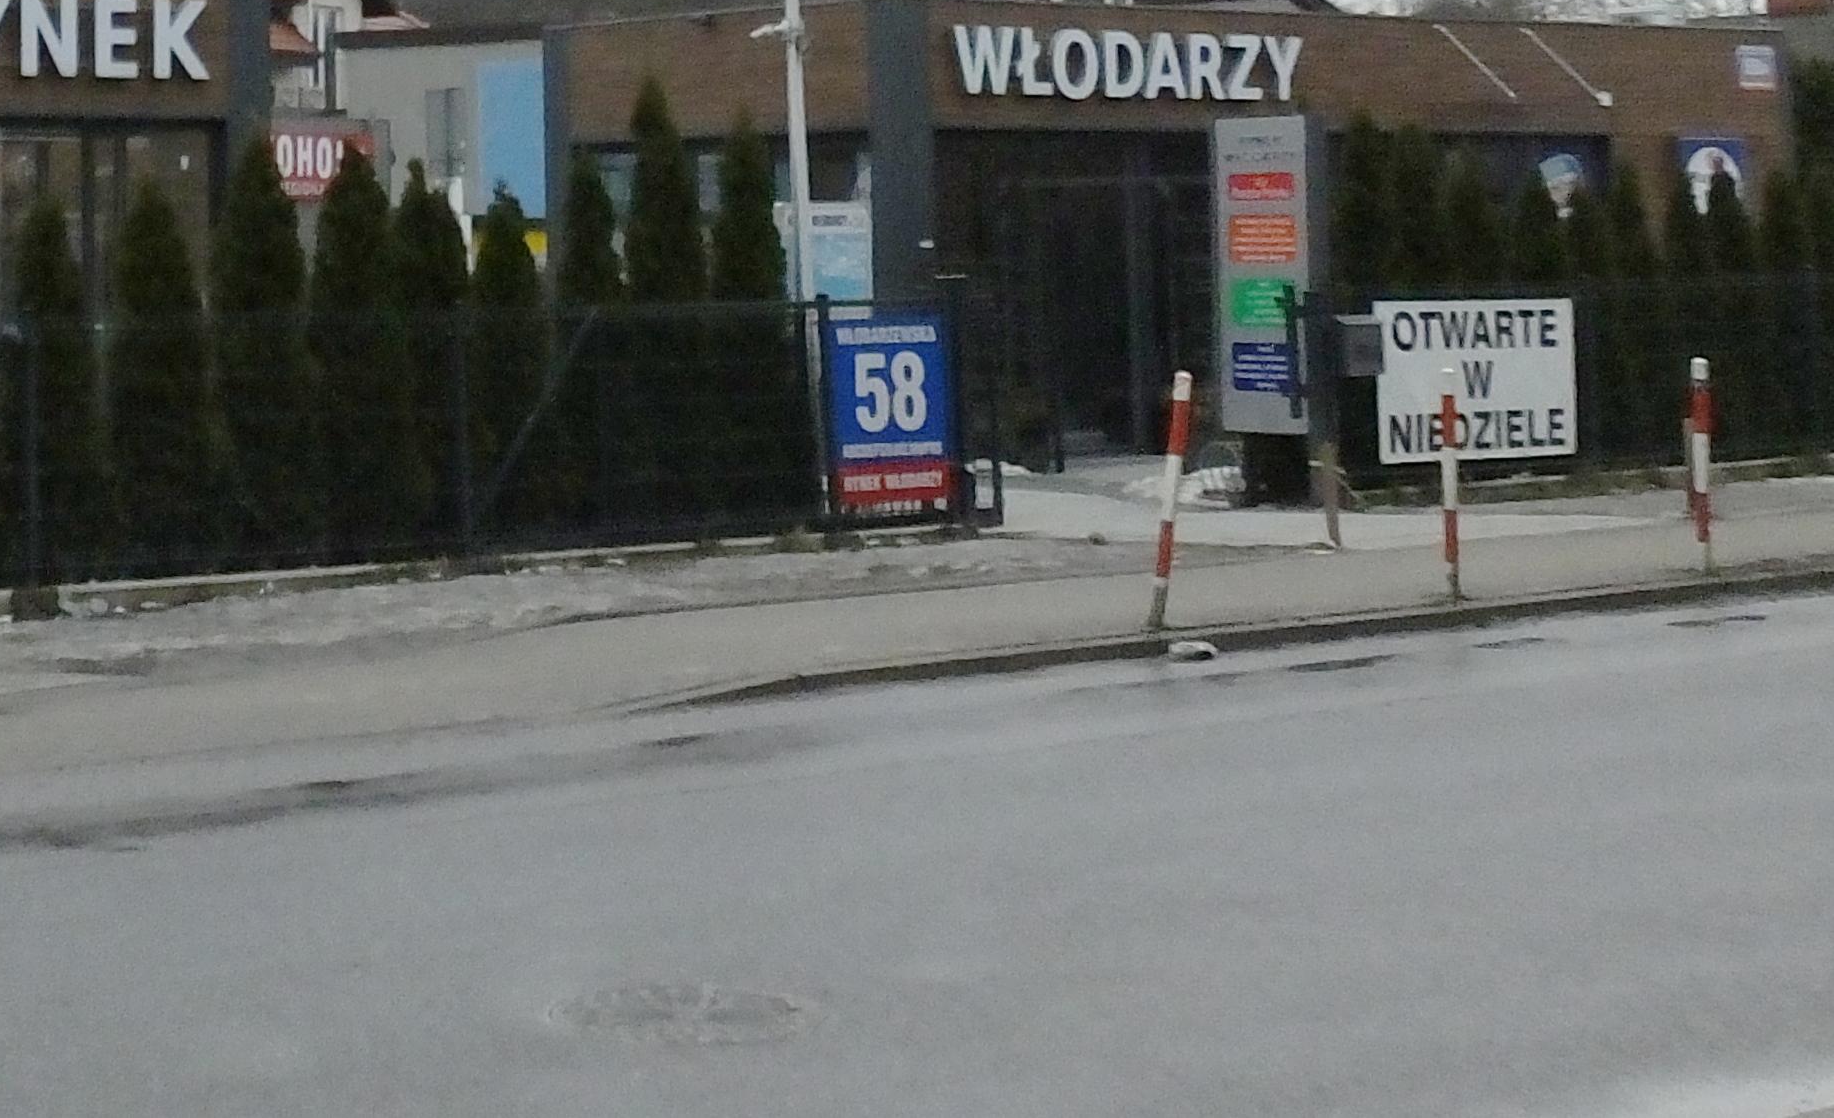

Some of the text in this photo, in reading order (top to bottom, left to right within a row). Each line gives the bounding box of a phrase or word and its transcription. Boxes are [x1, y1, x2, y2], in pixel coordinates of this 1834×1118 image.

[953, 24, 1304, 102] WŁODARZY
[1392, 309, 1559, 352] OTWARTE
[854, 350, 928, 433] 58
[1462, 360, 1494, 399] W
[1388, 408, 1566, 454] NIEDZIELE
